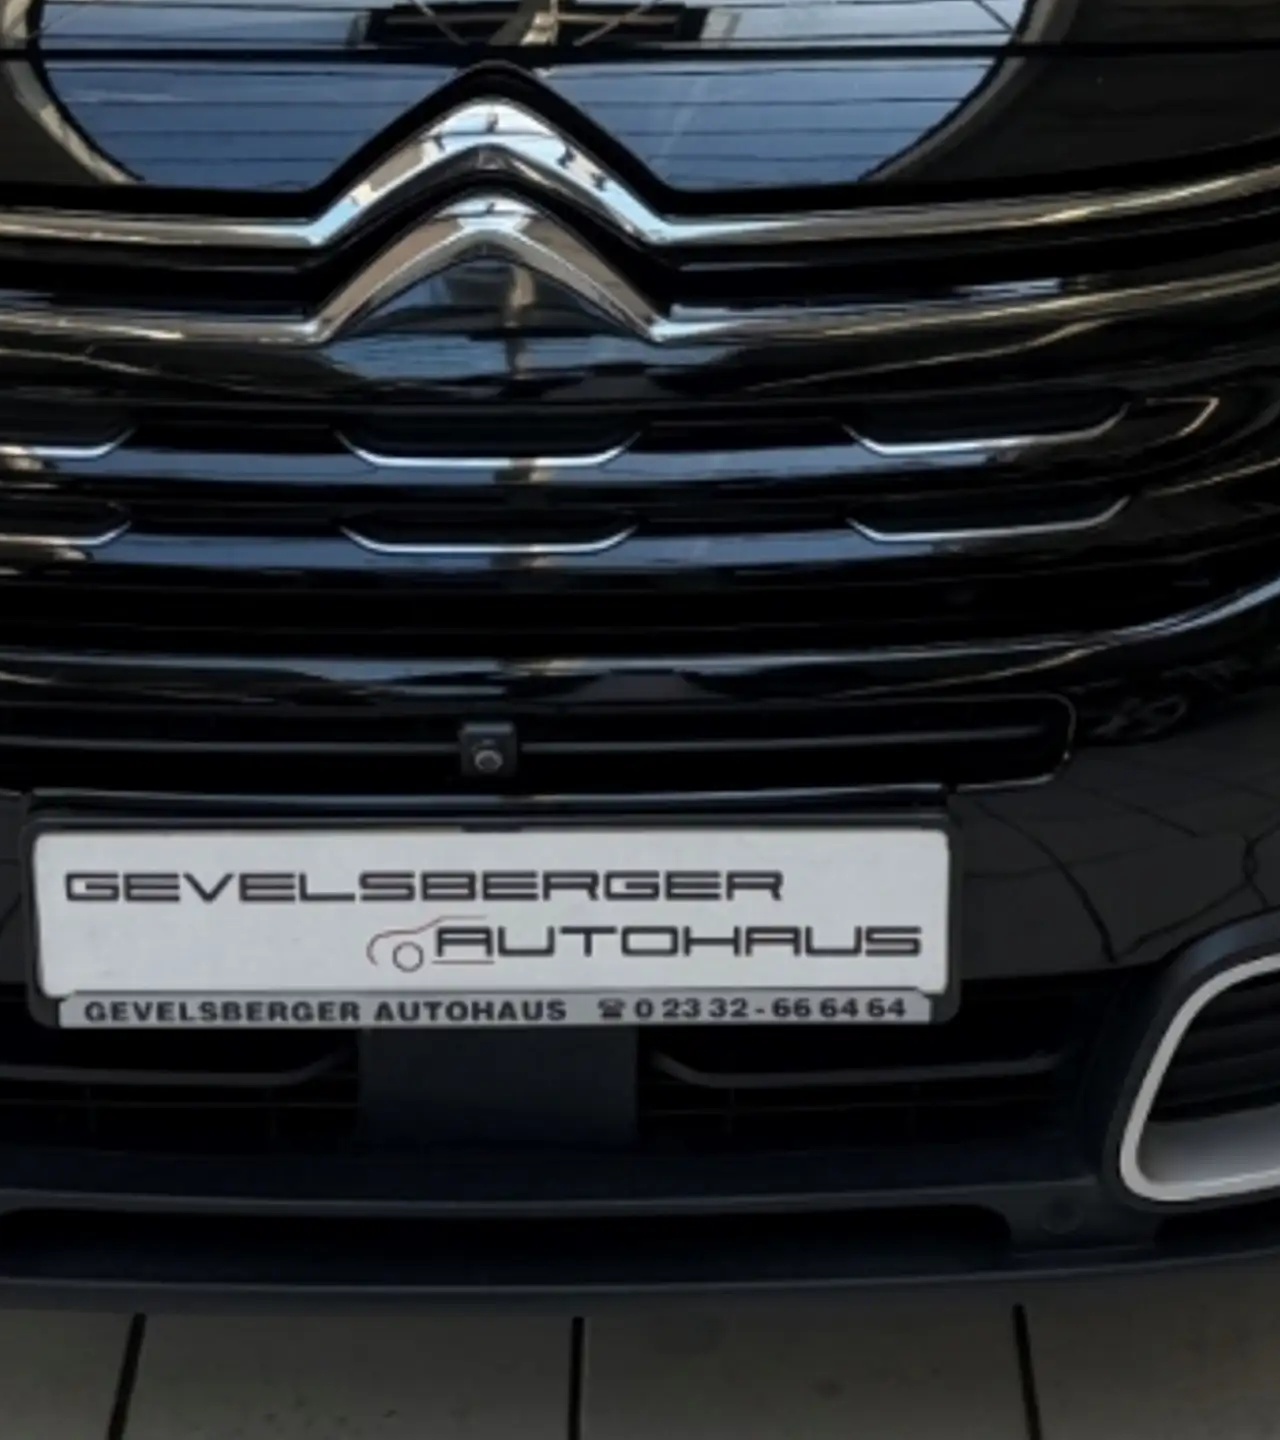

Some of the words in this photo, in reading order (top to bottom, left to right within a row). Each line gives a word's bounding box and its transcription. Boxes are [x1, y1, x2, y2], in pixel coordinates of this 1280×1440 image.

[64, 869, 785, 904] GEVELSBERGER
[435, 924, 923, 958] AUTOHAUS
[83, 1000, 362, 1023] GEVELSBERGER
[373, 998, 568, 1023] AUTOHAUS
